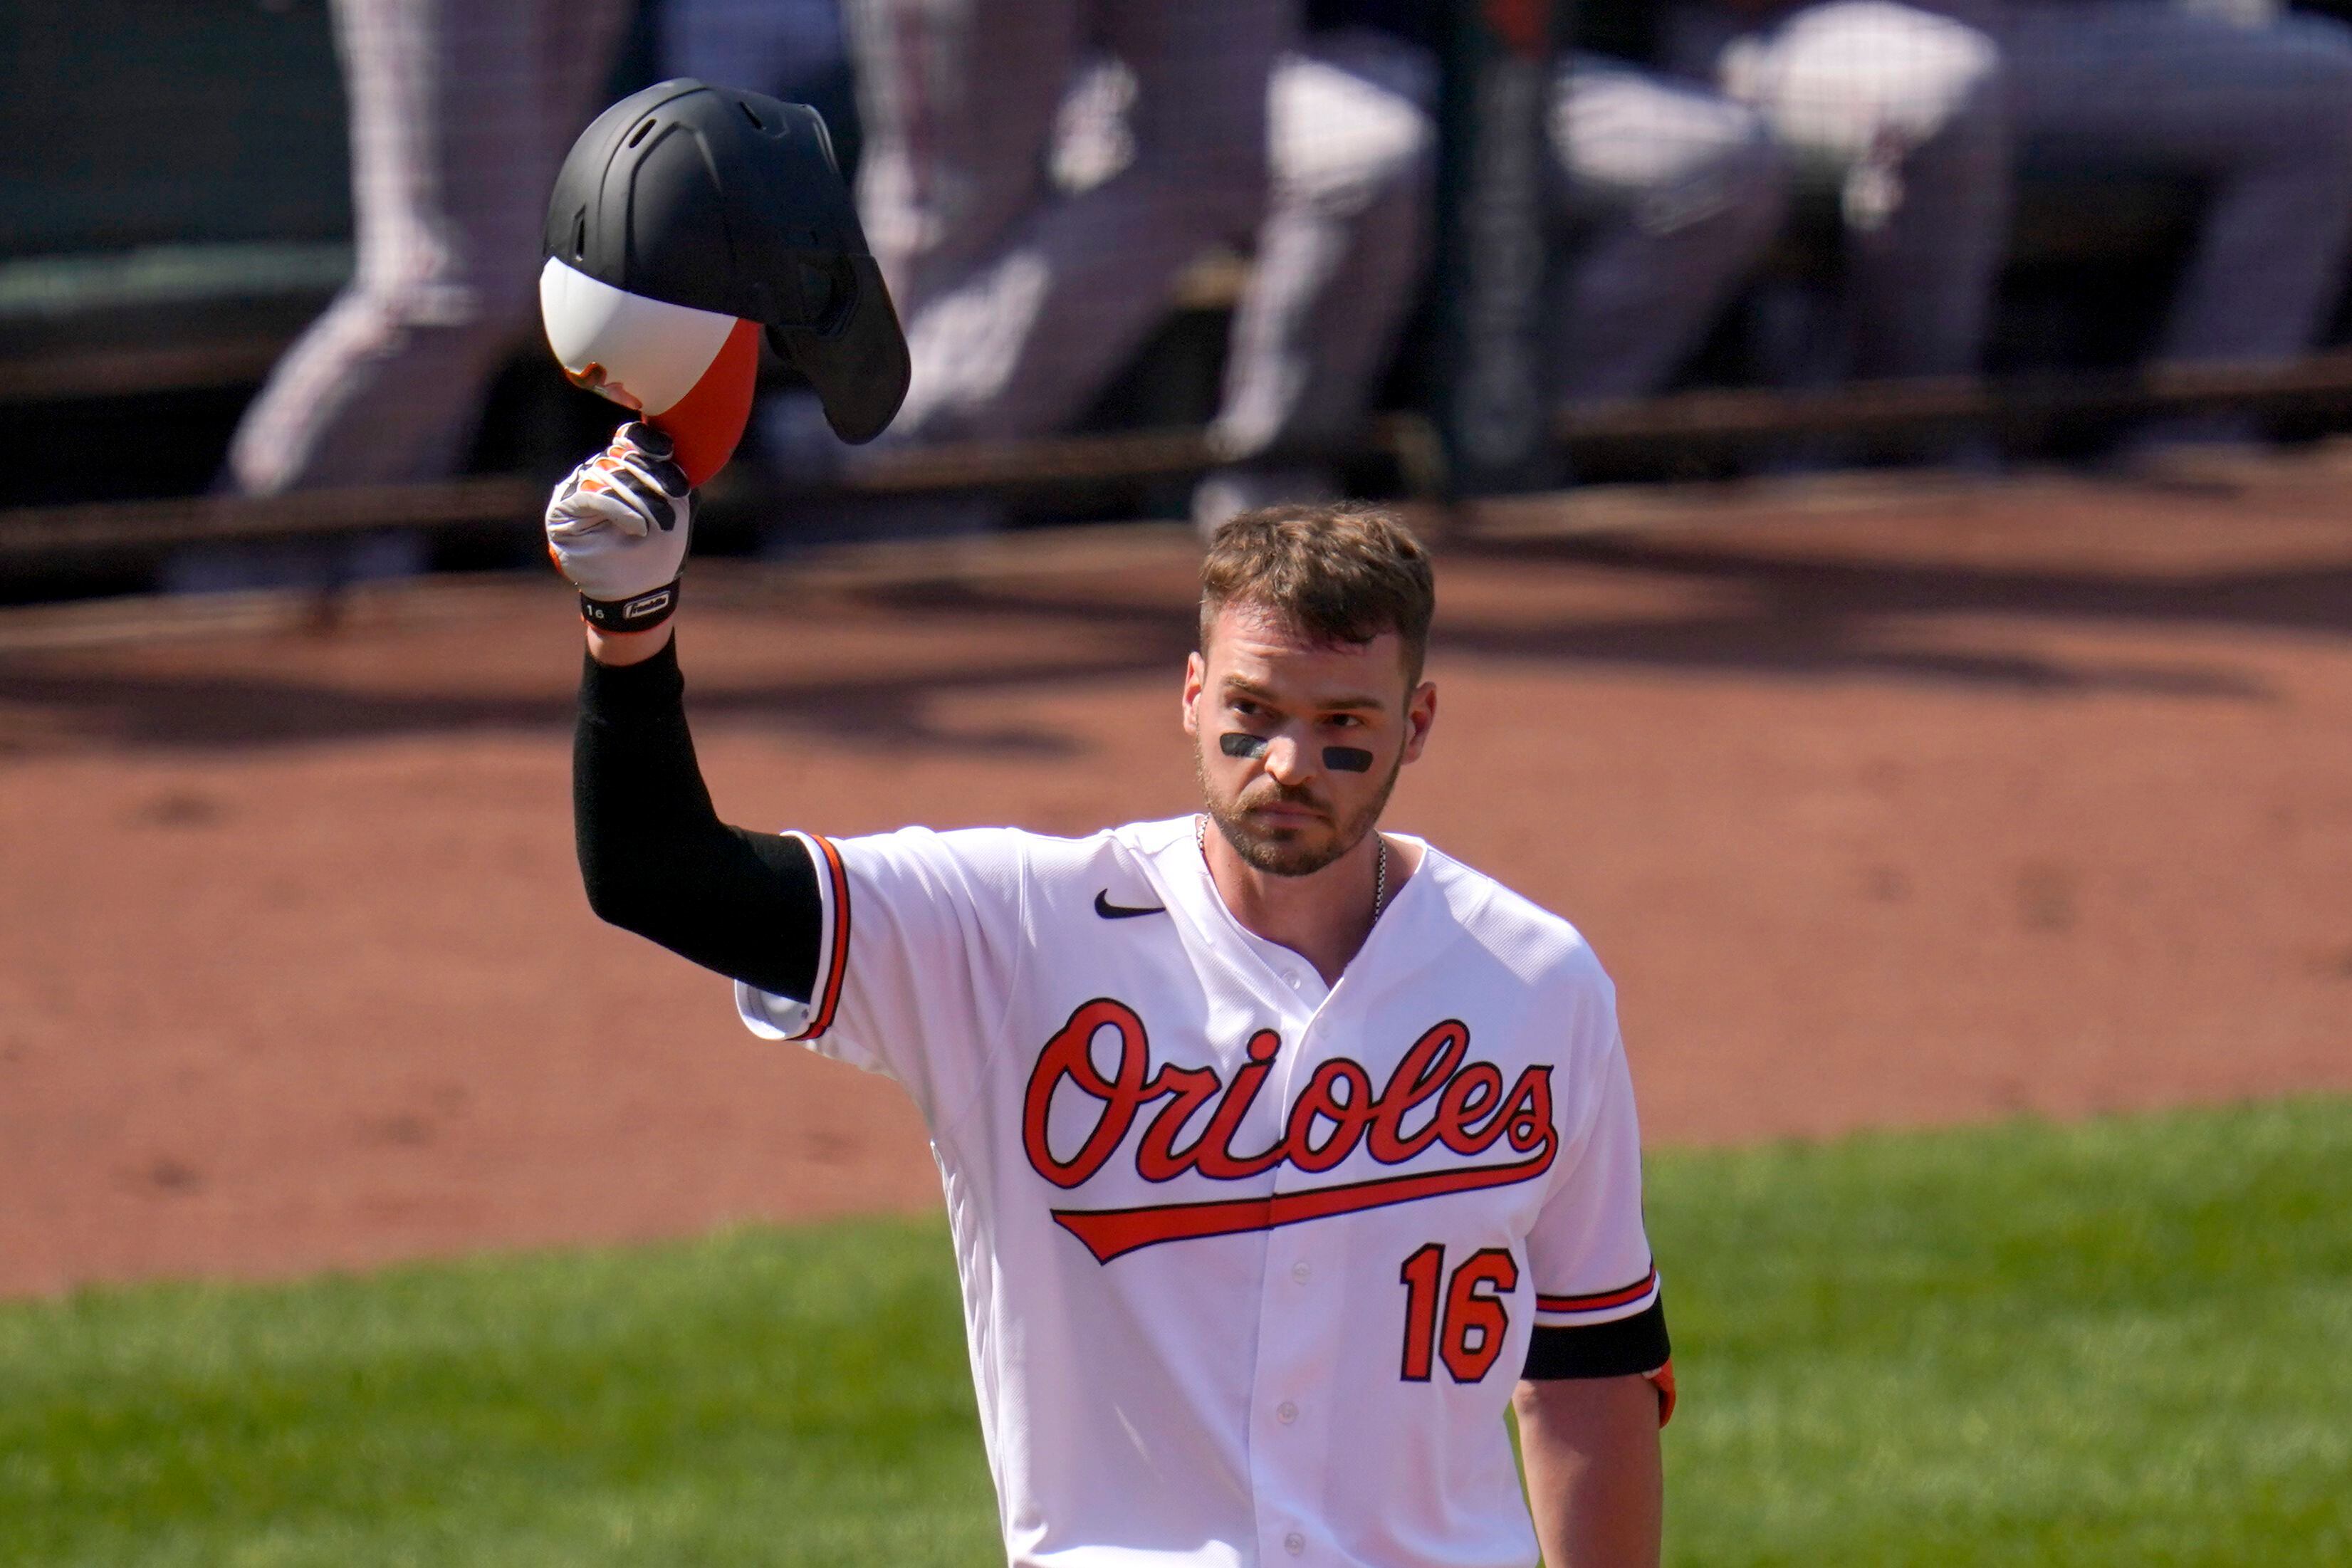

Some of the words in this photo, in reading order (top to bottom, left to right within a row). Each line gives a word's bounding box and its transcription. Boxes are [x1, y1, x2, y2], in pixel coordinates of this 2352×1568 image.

[587, 605, 604, 619] 16
[1022, 997, 1558, 1191] Orioles
[1401, 1243, 1519, 1384] 16
